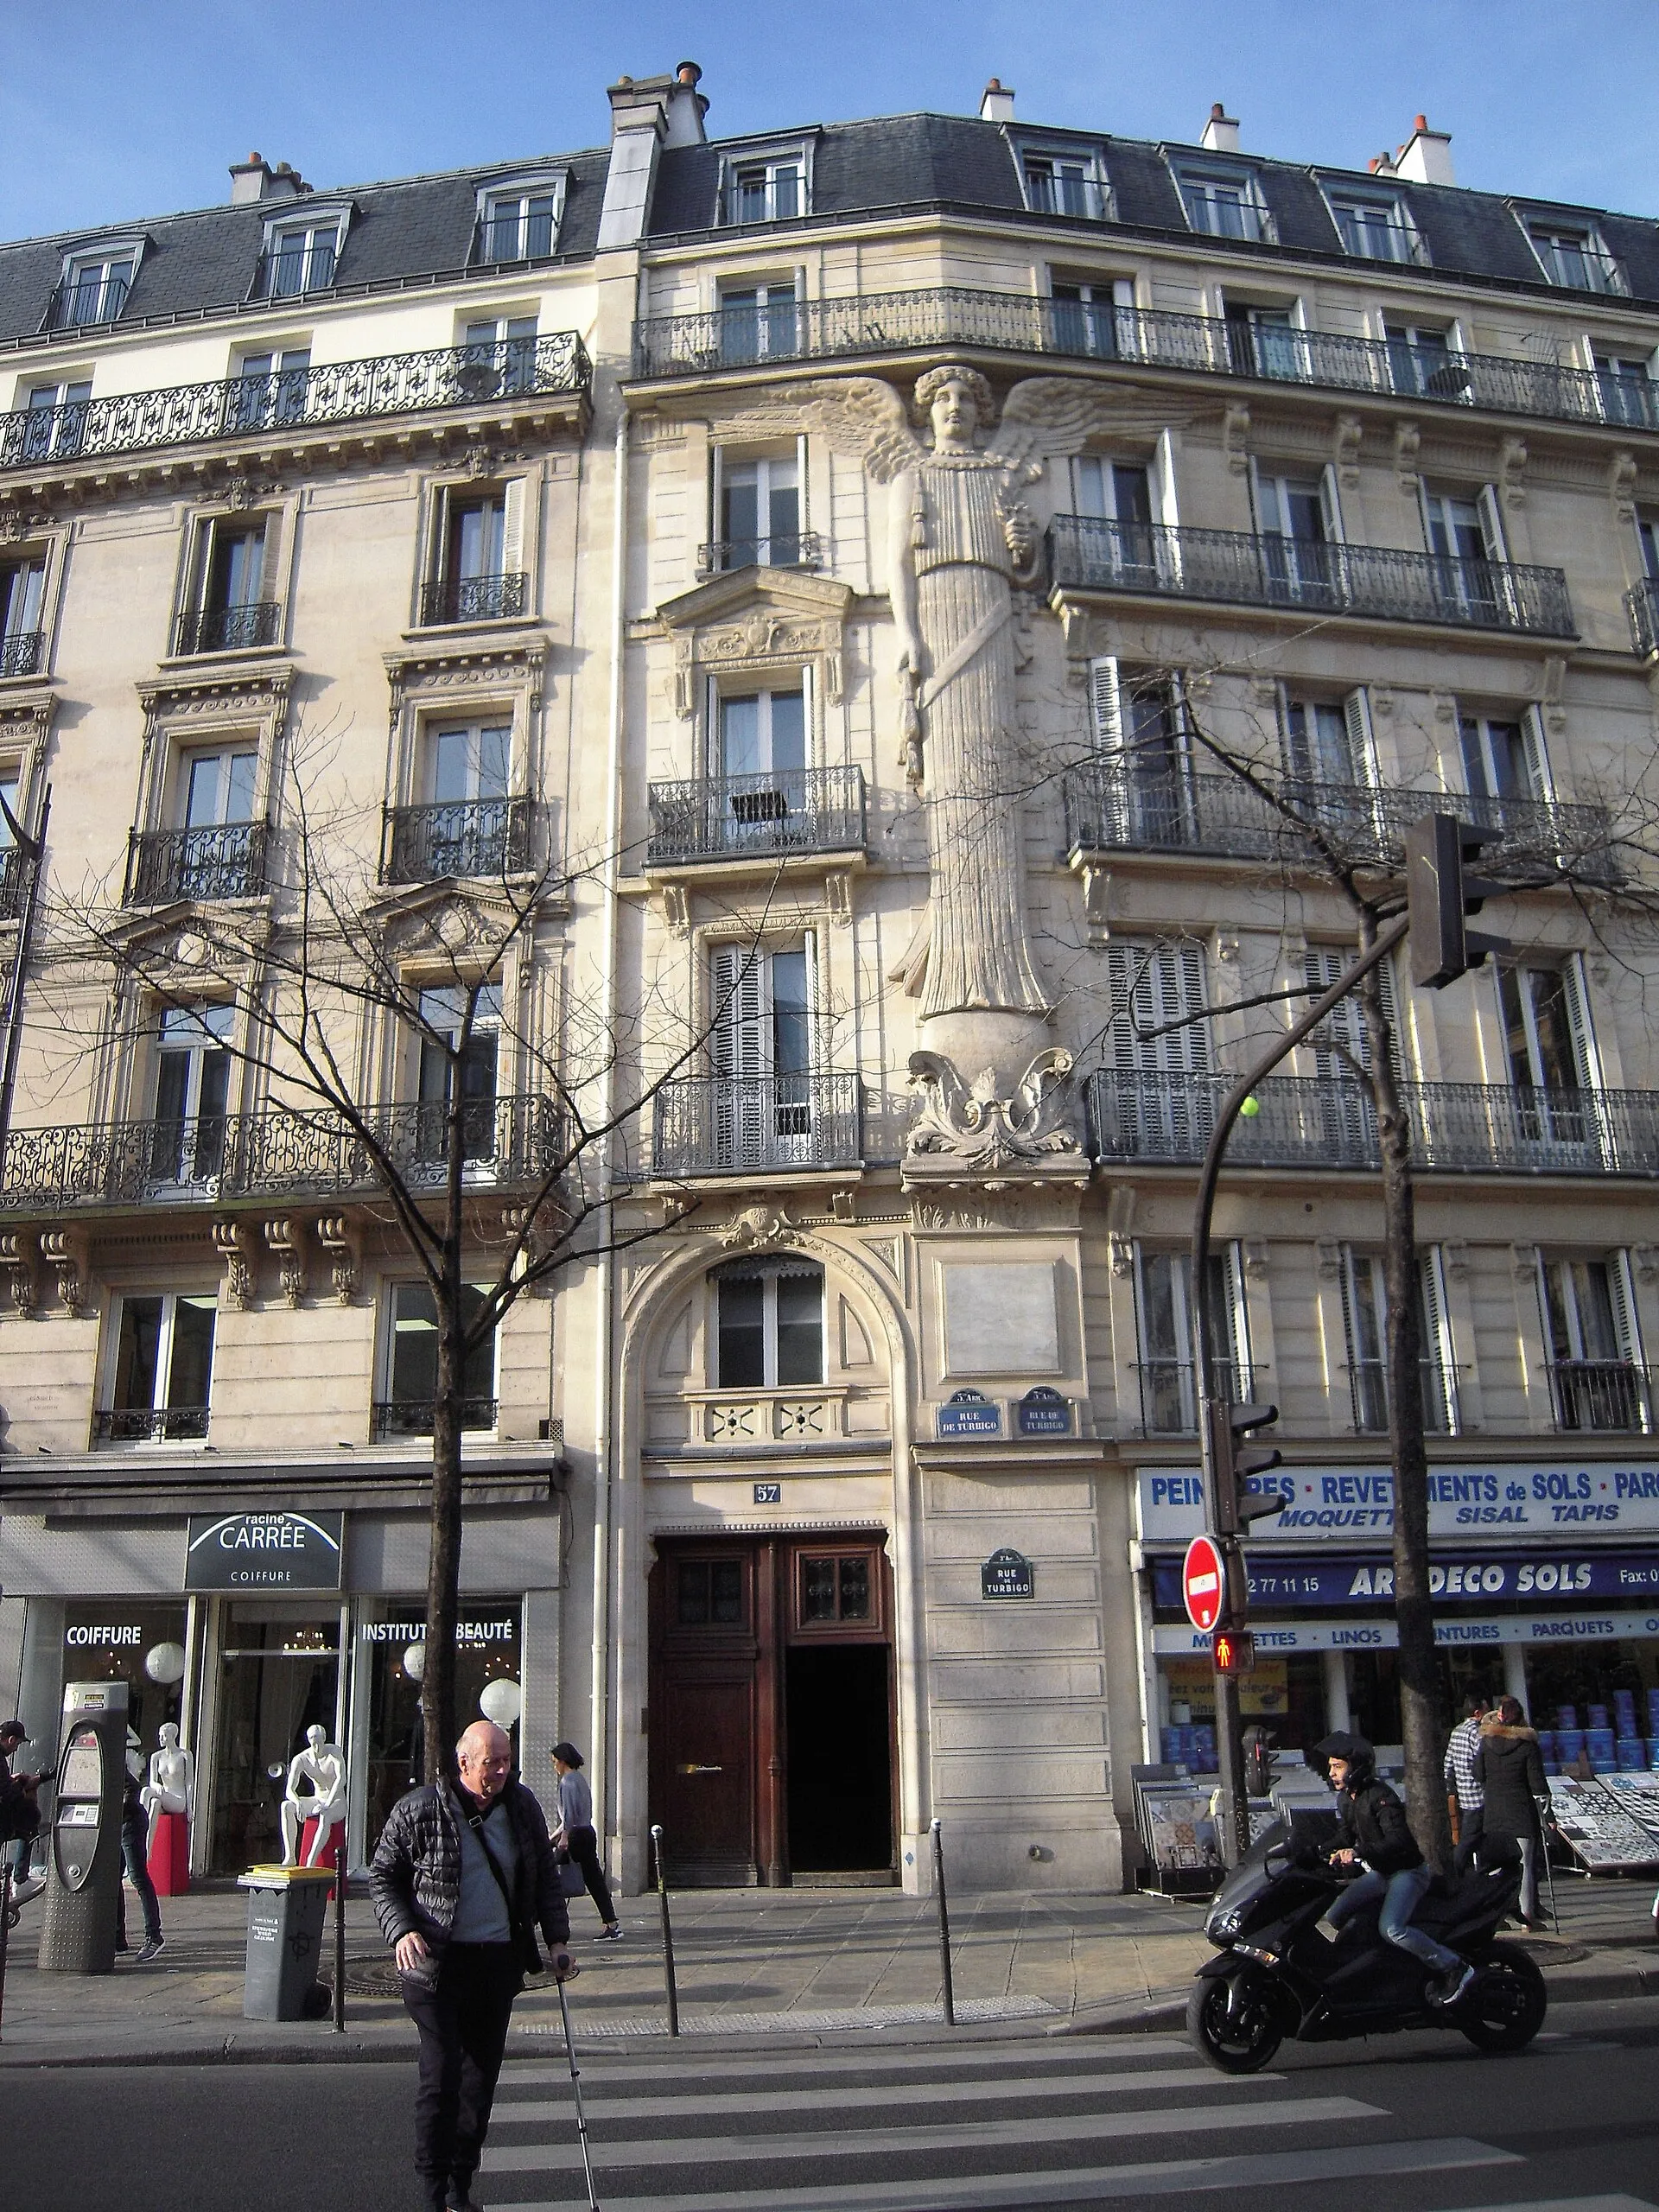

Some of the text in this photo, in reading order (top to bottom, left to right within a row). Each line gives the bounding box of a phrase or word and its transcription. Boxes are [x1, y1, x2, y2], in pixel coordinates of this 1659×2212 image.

[959, 1413, 980, 1421] RUE
[958, 1422, 996, 1431] TURBIGO
[758, 1485, 778, 1502] 57
[1506, 1482, 1526, 1500] de
[1532, 1473, 1591, 1500] SOLS
[1615, 1472, 1659, 1498] PAR
[245, 1514, 285, 1524] racine
[1456, 1506, 1529, 1523] SISAL
[1552, 1504, 1619, 1522] TAPIS
[219, 1522, 306, 1548] CARRÉE
[231, 1572, 291, 1581] COIFFURE
[997, 1569, 1017, 1578] RUE
[1260, 1578, 1277, 1592] 77
[1282, 1578, 1296, 1592] 11
[1303, 1577, 1319, 1592] 15
[1348, 1567, 1394, 1596] AR
[1428, 1565, 1505, 1593] DECO
[1516, 1563, 1592, 1592] SOLS
[1619, 1569, 1647, 1583] Fax:
[987, 1584, 1029, 1592] TURBIGO
[67, 1626, 142, 1645] COIFFURE
[362, 1618, 512, 1641] INSTITUT BEAUTÉ
[1332, 1630, 1382, 1643] LINOS
[1532, 1620, 1614, 1637] PARQUETS
